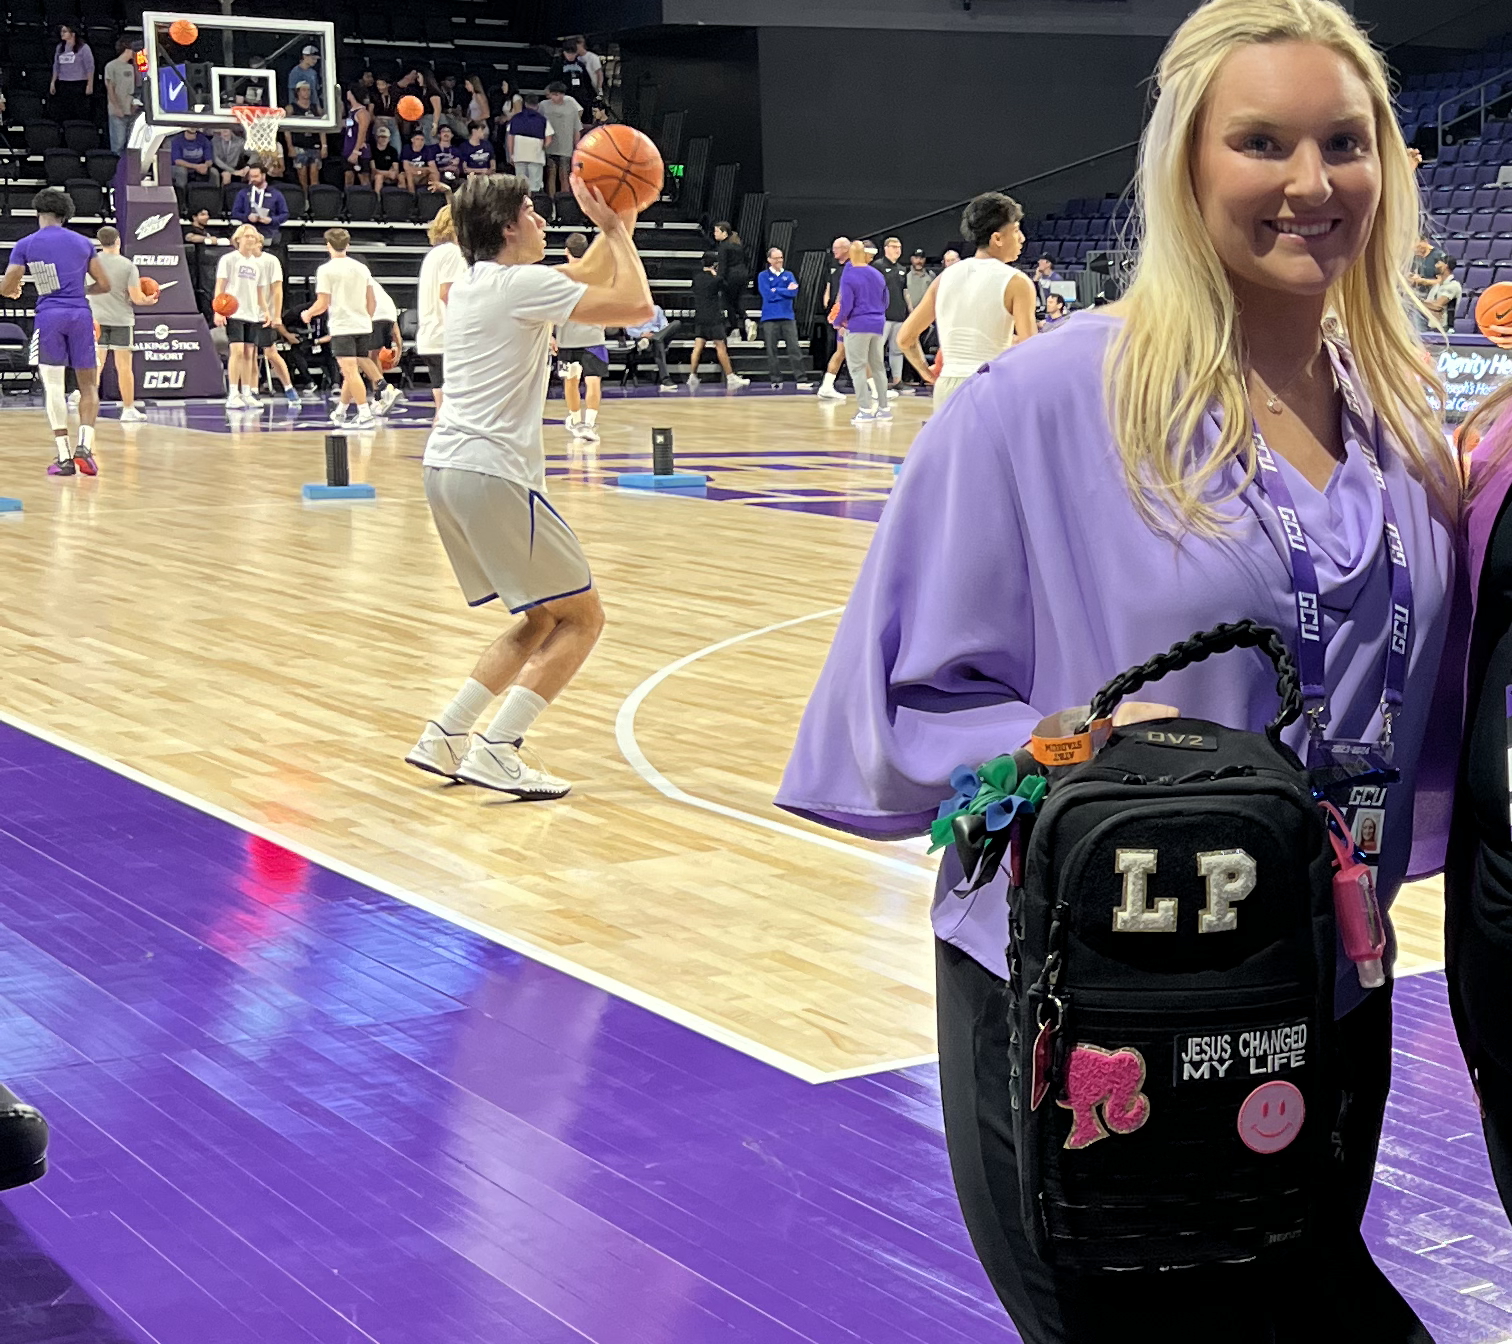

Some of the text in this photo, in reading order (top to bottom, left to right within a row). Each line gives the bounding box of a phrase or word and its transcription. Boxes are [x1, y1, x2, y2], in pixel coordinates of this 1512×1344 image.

[143, 370, 186, 389] GCU
[1437, 352, 1490, 380] Dignity
[1277, 505, 1307, 552] GCU
[1385, 522, 1407, 568] GCU
[1298, 591, 1320, 642] GCU
[1391, 603, 1410, 655] GCU
[1147, 731, 1203, 747] DV2
[1348, 786, 1387, 807] GCU
[1181, 1023, 1307, 1062] JESUS CHANGED
[1183, 1049, 1306, 1081] MY LIFE
